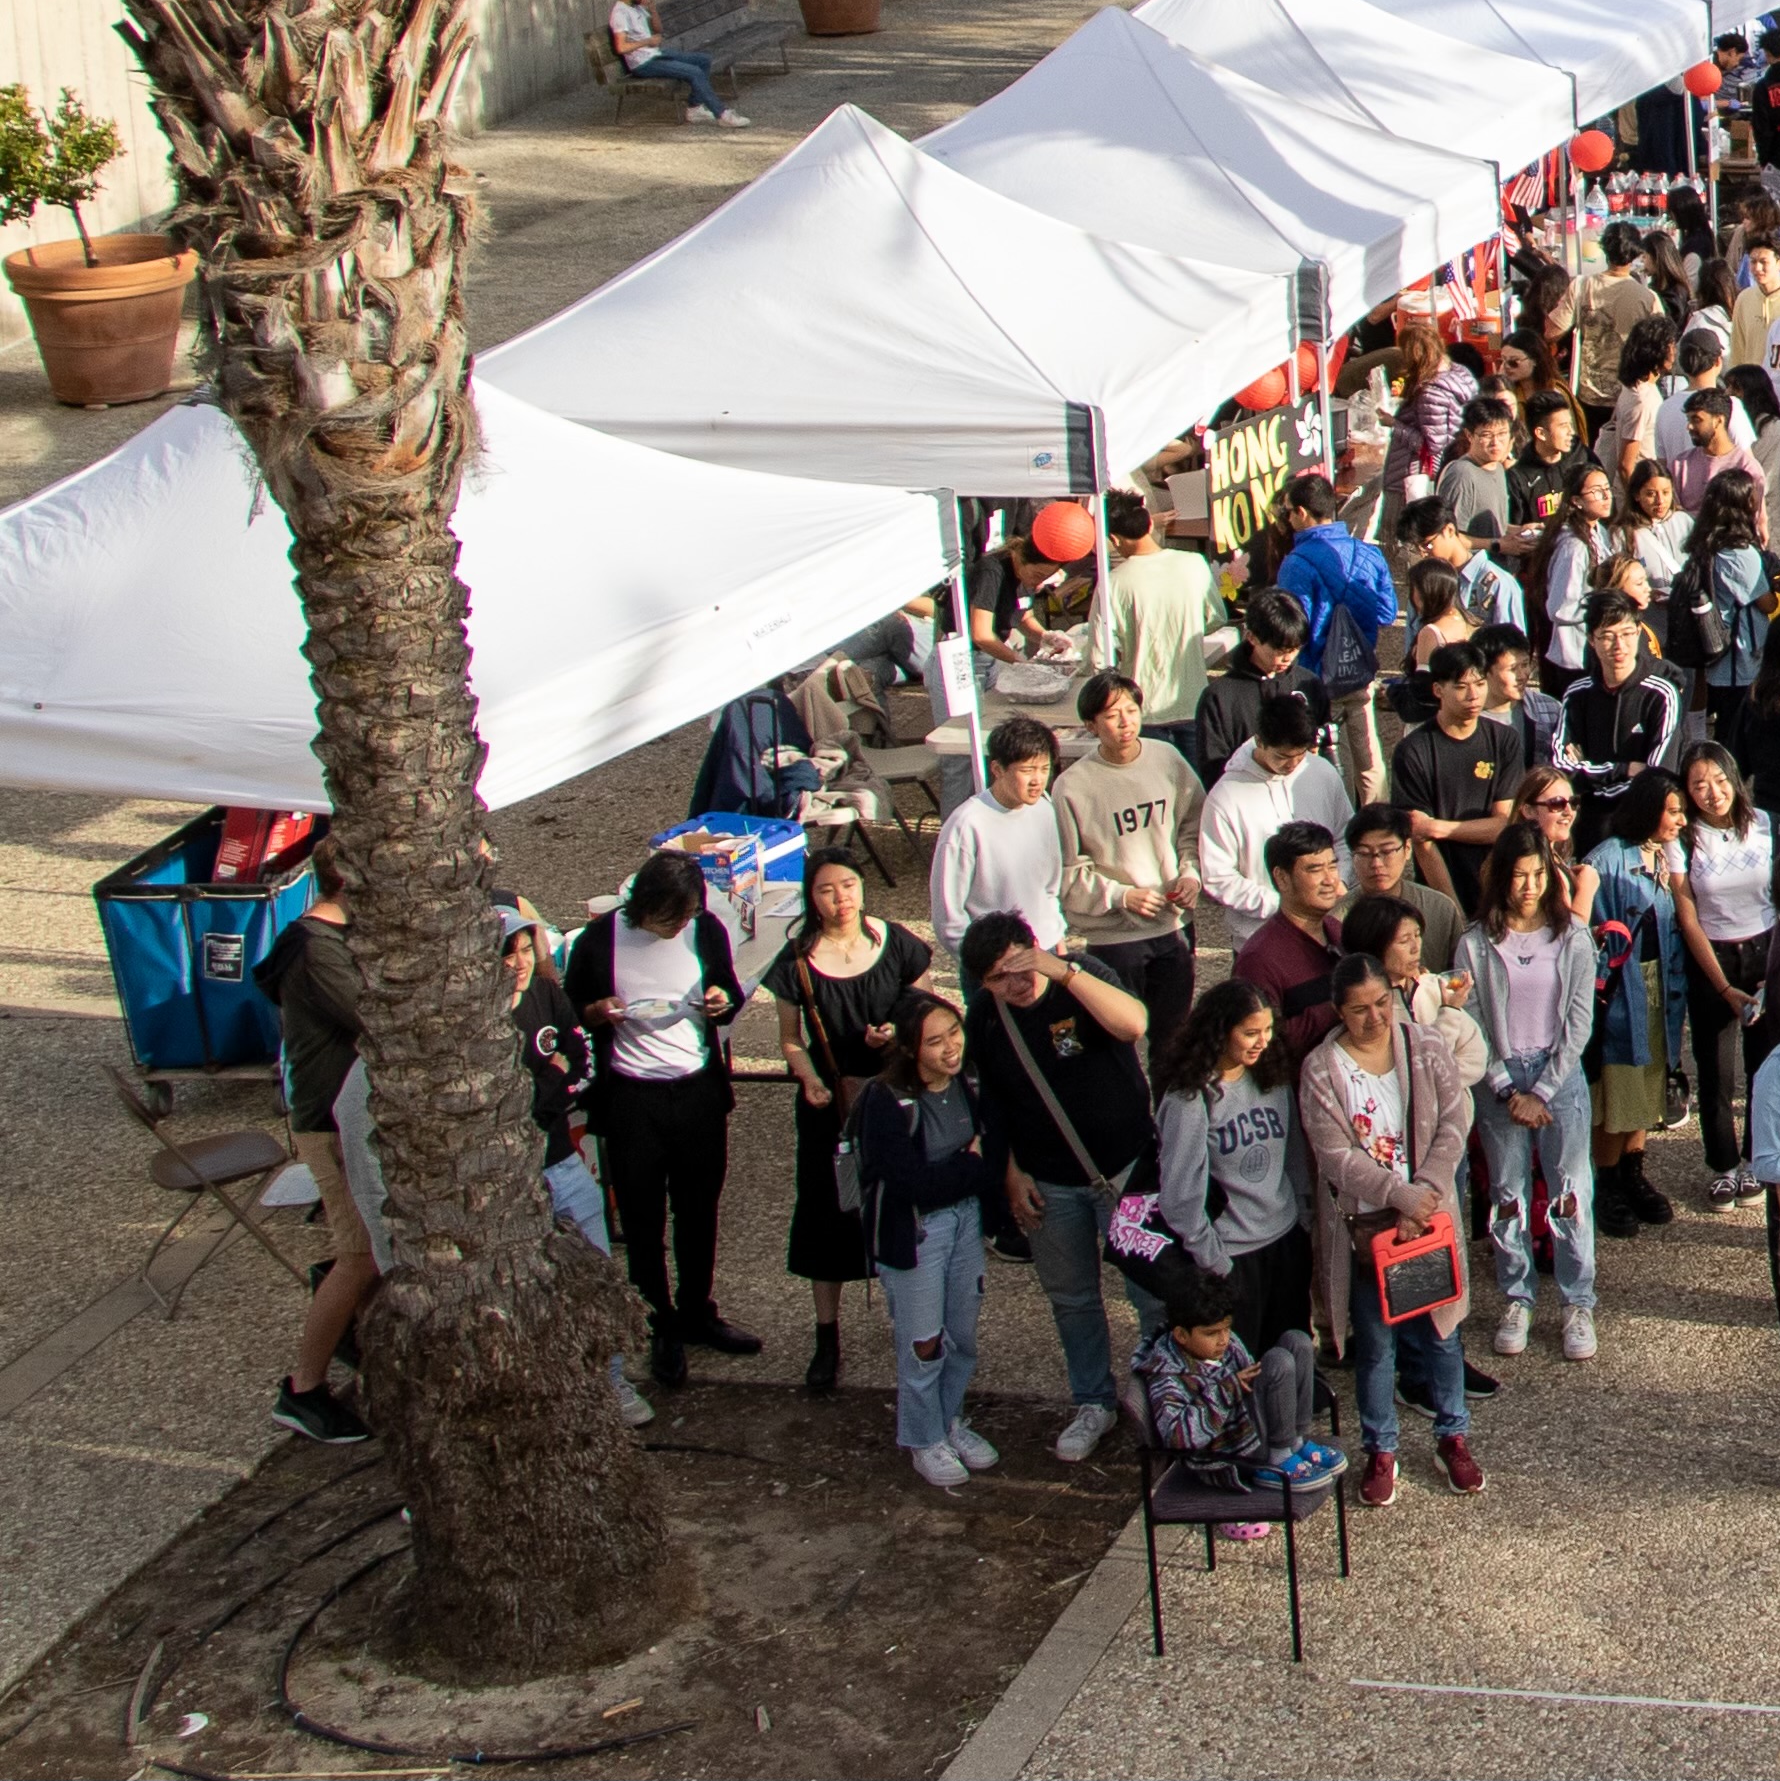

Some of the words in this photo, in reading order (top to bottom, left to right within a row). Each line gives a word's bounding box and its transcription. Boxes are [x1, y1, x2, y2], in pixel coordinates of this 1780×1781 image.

[1210, 414, 1287, 493] HONG
[1113, 799, 1166, 837] 1977
[1216, 1107, 1285, 1155] UCSB
[1115, 1225, 1170, 1261] STREET
